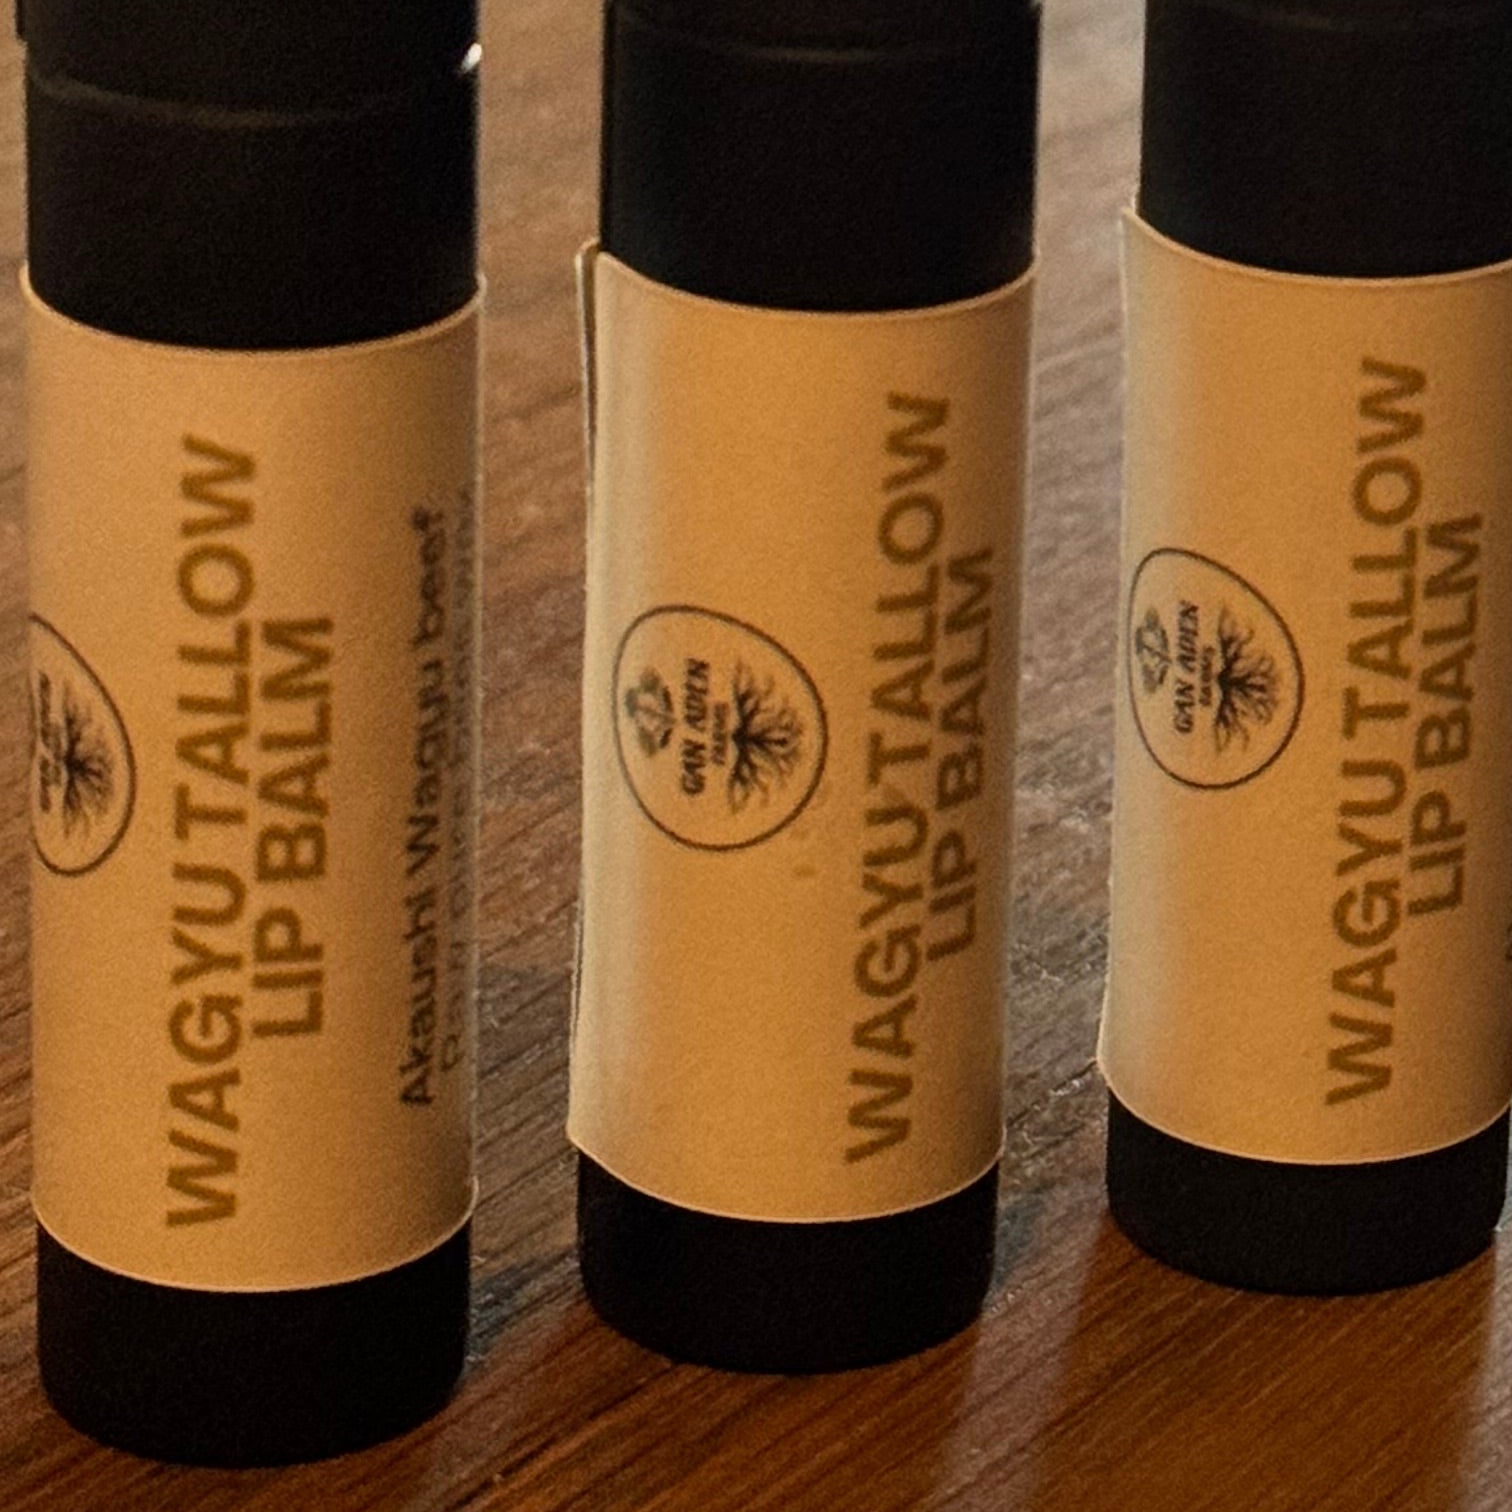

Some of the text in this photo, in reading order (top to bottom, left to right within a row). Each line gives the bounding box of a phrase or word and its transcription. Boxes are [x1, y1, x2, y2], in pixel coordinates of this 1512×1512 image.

[165, 434, 258, 1228] WAGYU TALLOW
[254, 615, 334, 1038] LIP BALM
[399, 506, 450, 1105] Akaushi Wagyu beef
[843, 391, 950, 1164] WAGYU TALLOW
[927, 548, 994, 964] LIP BALM
[1323, 356, 1429, 1106] WAGYU TALLOW
[1408, 512, 1482, 917] LIP BALM
